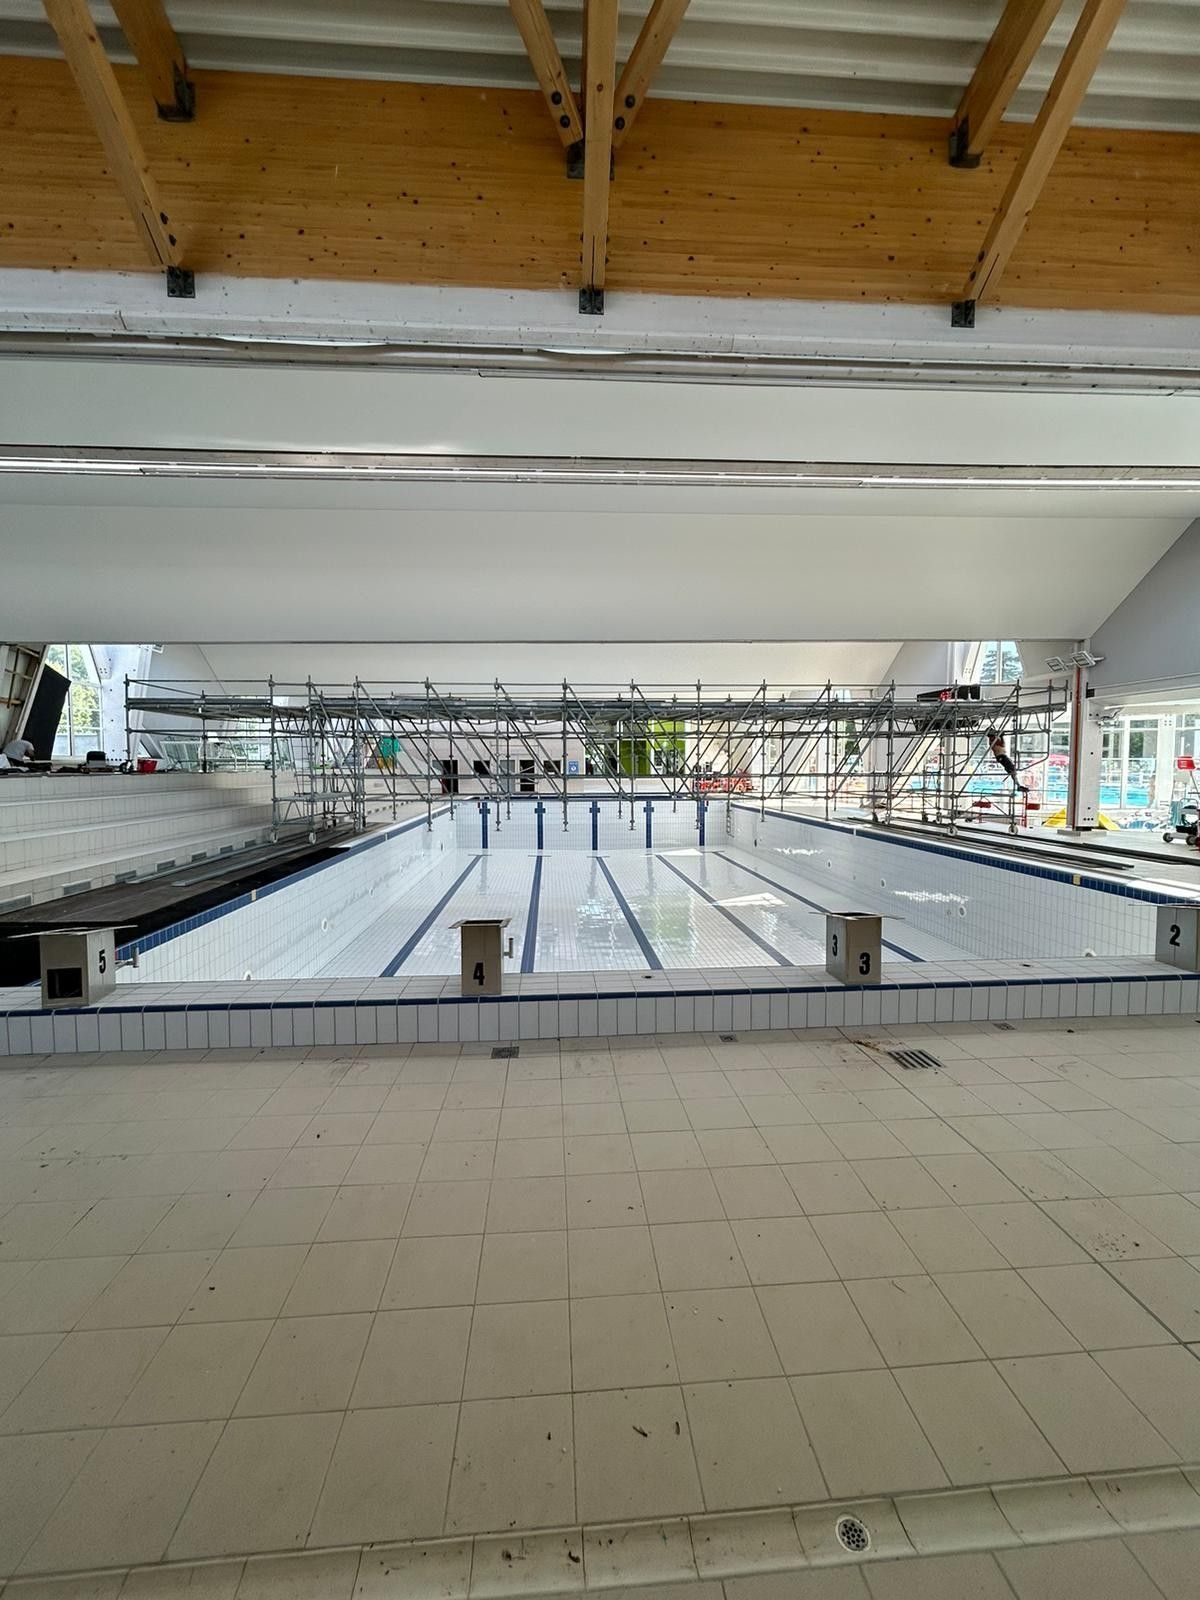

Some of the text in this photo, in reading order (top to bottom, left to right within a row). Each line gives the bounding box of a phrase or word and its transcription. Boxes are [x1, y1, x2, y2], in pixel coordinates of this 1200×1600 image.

[832, 934, 838, 957] 3
[1169, 924, 1181, 947] 2
[99, 949, 107, 974] 5
[859, 952, 871, 975] 3
[473, 962, 485, 986] 4
